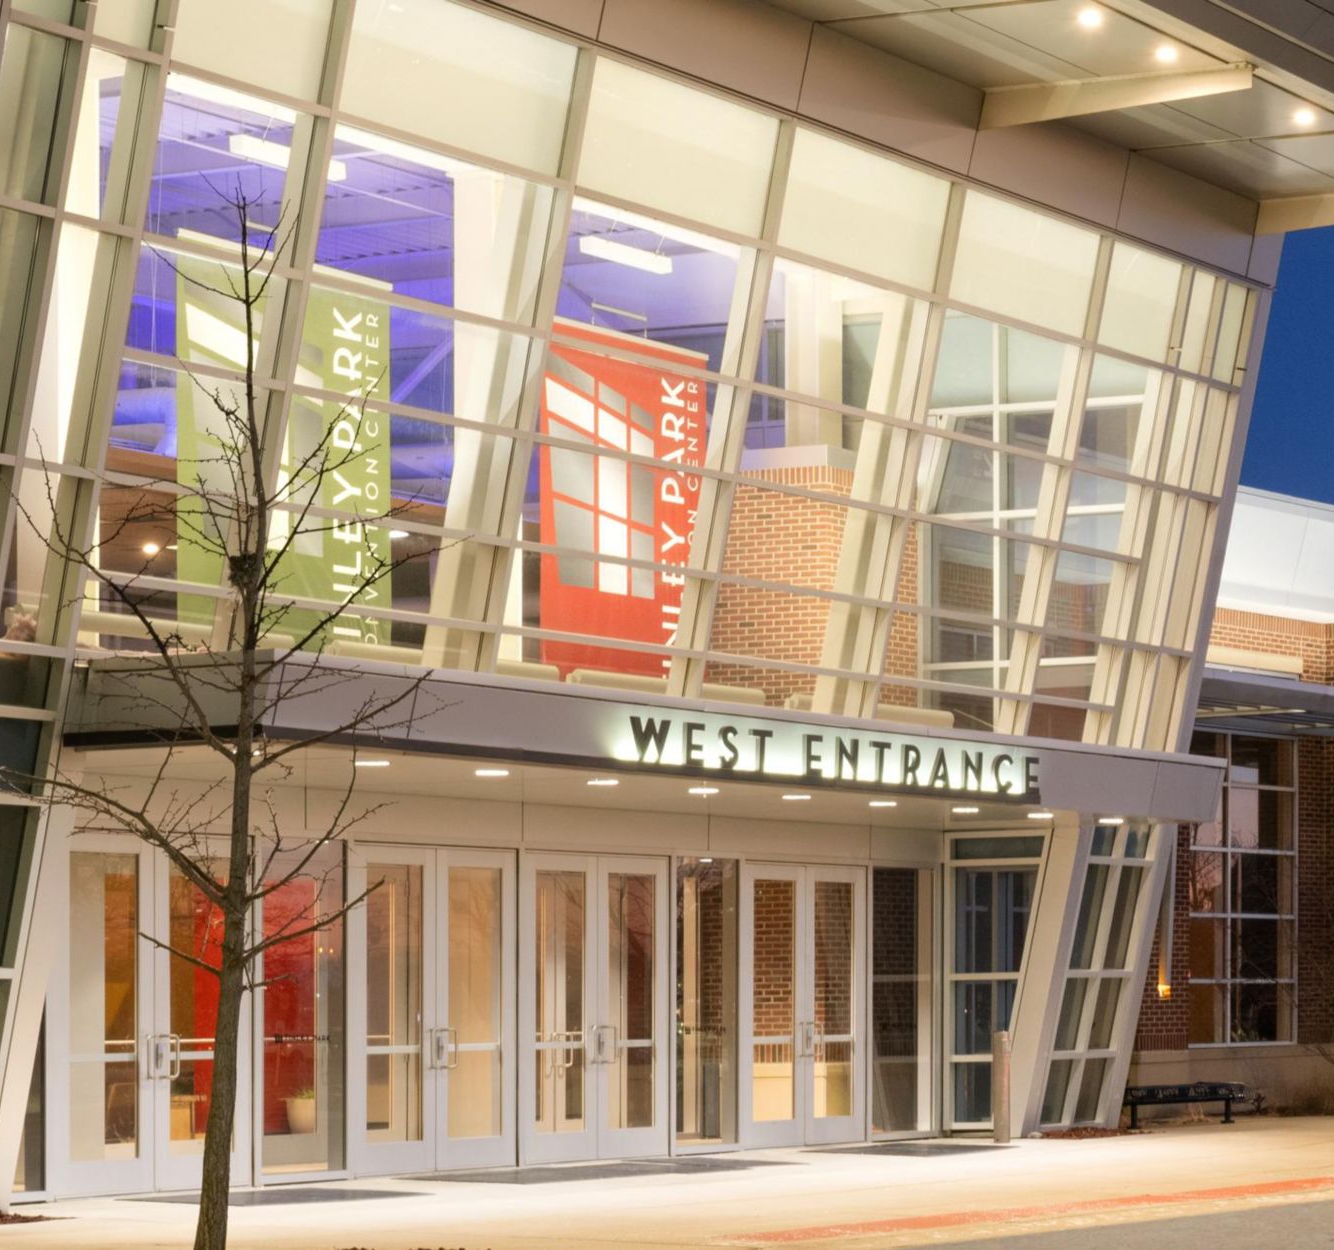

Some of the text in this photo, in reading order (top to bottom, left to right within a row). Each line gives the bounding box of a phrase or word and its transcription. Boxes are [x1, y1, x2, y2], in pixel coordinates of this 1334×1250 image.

[332, 306, 363, 639] INLEY PARK
[660, 376, 685, 505] PARK
[686, 381, 699, 492] CENTER
[629, 716, 1041, 795] WEST ENTRANCE
